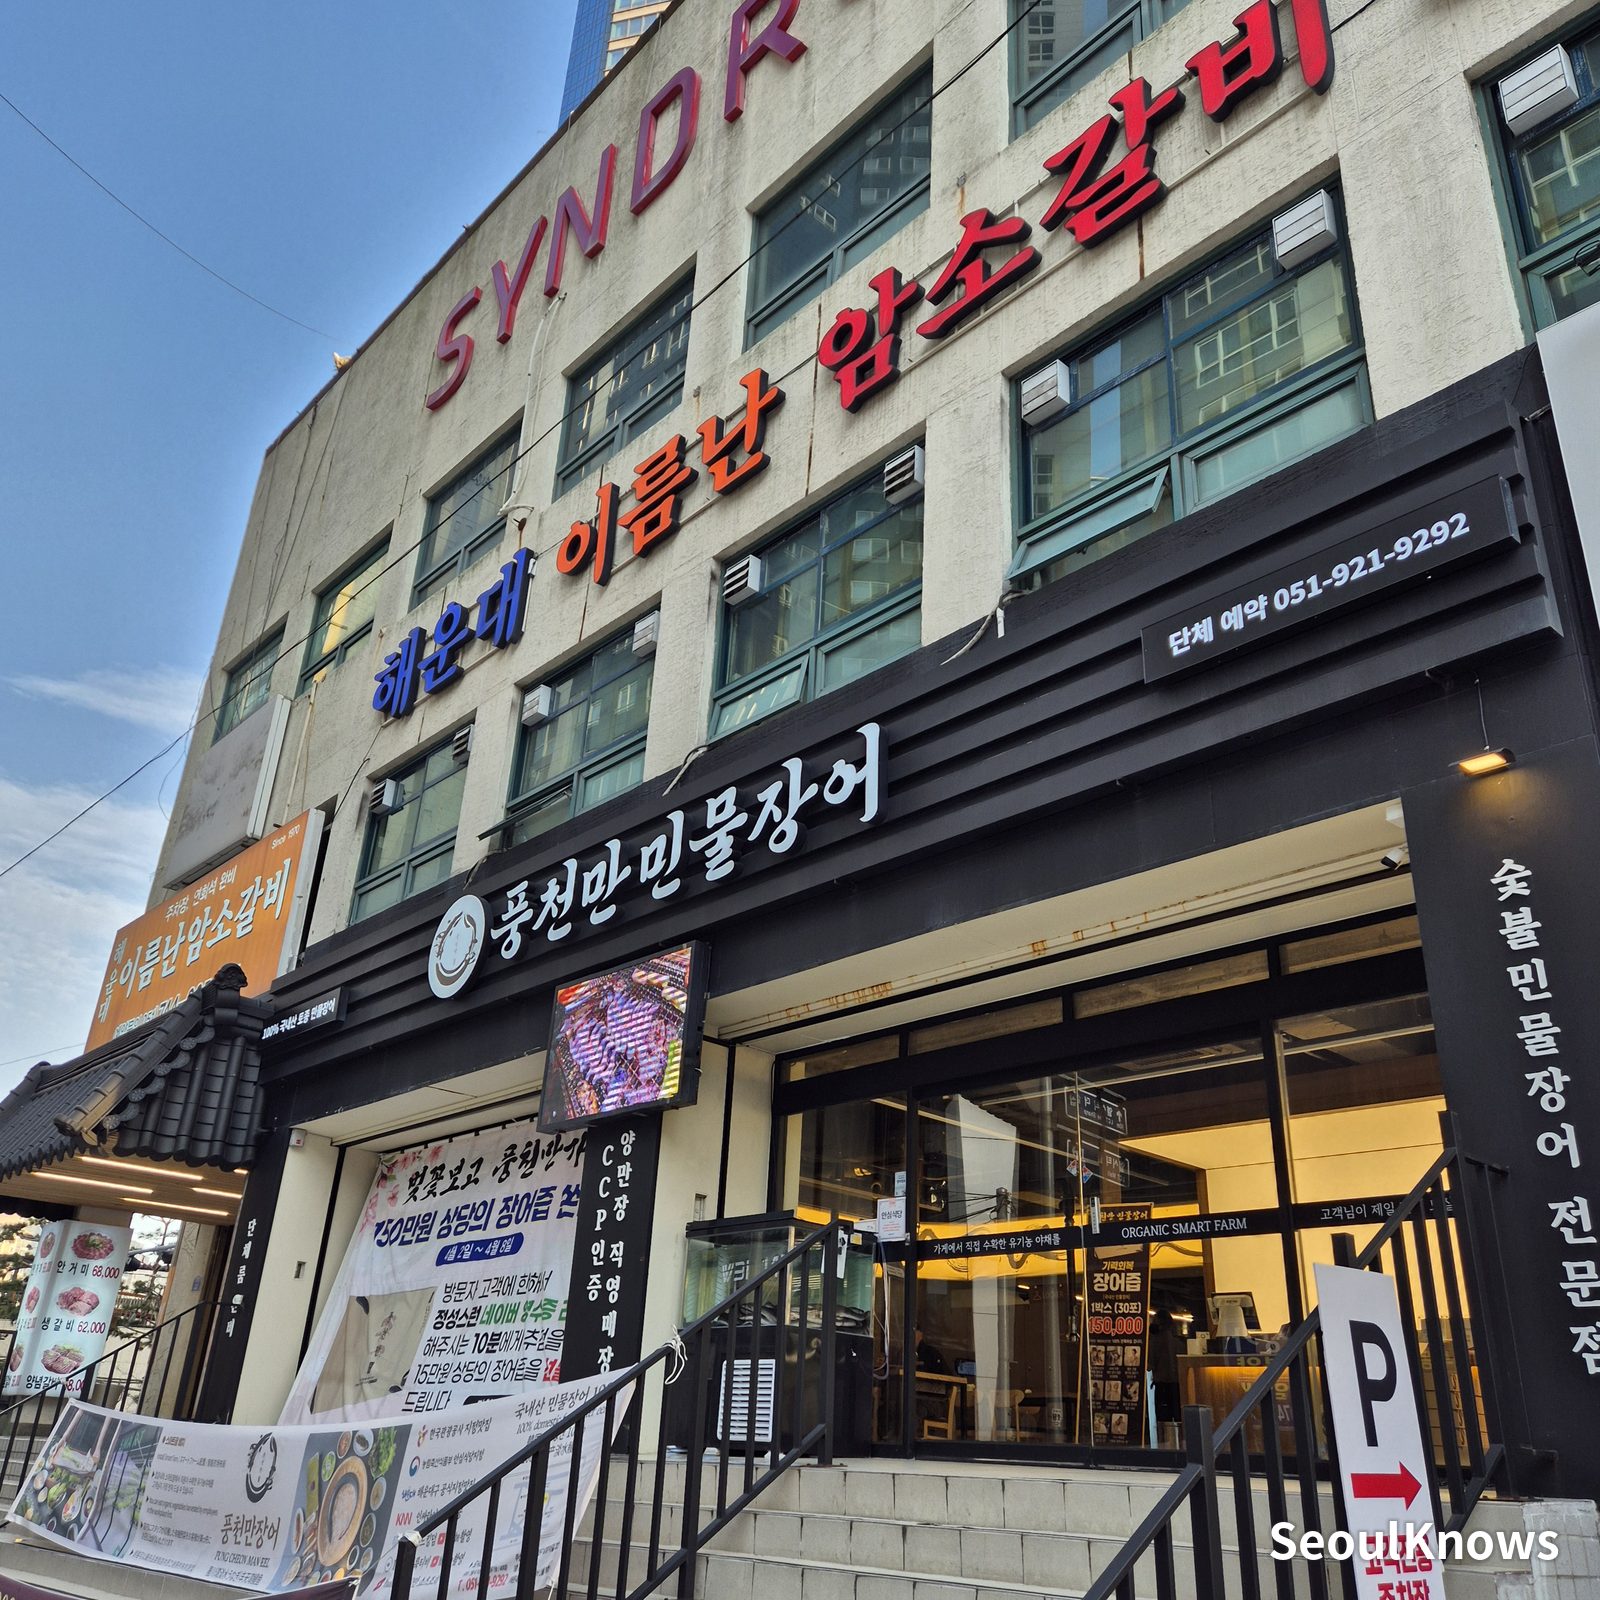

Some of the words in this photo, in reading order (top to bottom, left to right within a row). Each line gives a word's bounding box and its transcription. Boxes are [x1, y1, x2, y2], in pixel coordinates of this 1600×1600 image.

[426, 0, 853, 411] SYNDR
[373, 547, 535, 718] 해운대
[556, 368, 786, 585] 이름난
[818, 0, 1335, 413] 암소갈비
[1168, 616, 1214, 657] 단체
[1220, 594, 1268, 631] 예약
[1273, 511, 1470, 611] 051-921-9292
[165, 895, 190, 921] 주차장
[219, 865, 237, 891] 완비
[119, 857, 292, 998] 이름난암소갈비
[98, 937, 128, 1024] 해운대
[261, 1023, 280, 1040] 100%
[280, 1013, 298, 1033] 국내산
[297, 1008, 311, 1026] 토종
[310, 997, 336, 1020] 민물장어
[436, 1197, 496, 1240] 상당의
[495, 1185, 558, 1230] 장어즙
[1121, 1223, 1170, 1239] ORGANIC
[1172, 1219, 1212, 1235] SMART
[1214, 1216, 1248, 1231] FARM
[1319, 1204, 1368, 1221] 고객님이
[1371, 1201, 1396, 1218] 제일
[933, 1241, 963, 1255] 가게에서
[965, 1240, 981, 1252] 직접
[983, 1237, 1007, 1251] 수확한
[1008, 1235, 1033, 1248] 유기농
[1035, 1232, 1062, 1246] 야채를
[1093, 1272, 1142, 1292] 장어즙
[1101, 1260, 1135, 1271] 기력회복
[441, 1280, 480, 1304] 방문자
[478, 1274, 518, 1299] 고객에
[517, 1270, 554, 1295] 한해서
[432, 1305, 482, 1331] 정성스런
[479, 1302, 521, 1326] 네이버
[520, 1297, 558, 1323] 영수증
[1090, 1302, 1113, 1314] 1박스
[1088, 1316, 1144, 1337] 150,000
[422, 1333, 471, 1357] 해주시는
[413, 1362, 453, 1385] 15만원
[450, 1359, 491, 1384] 상당의
[490, 1356, 543, 1383] 장어즙을
[1348, 1319, 1398, 1448] P
[401, 1389, 453, 1413] 드립니다
[514, 1396, 546, 1419] 국내산
[548, 1385, 591, 1413] 민물장어
[219, 1512, 282, 1551] 풍천만장어
[395, 1511, 413, 1526] KNN
